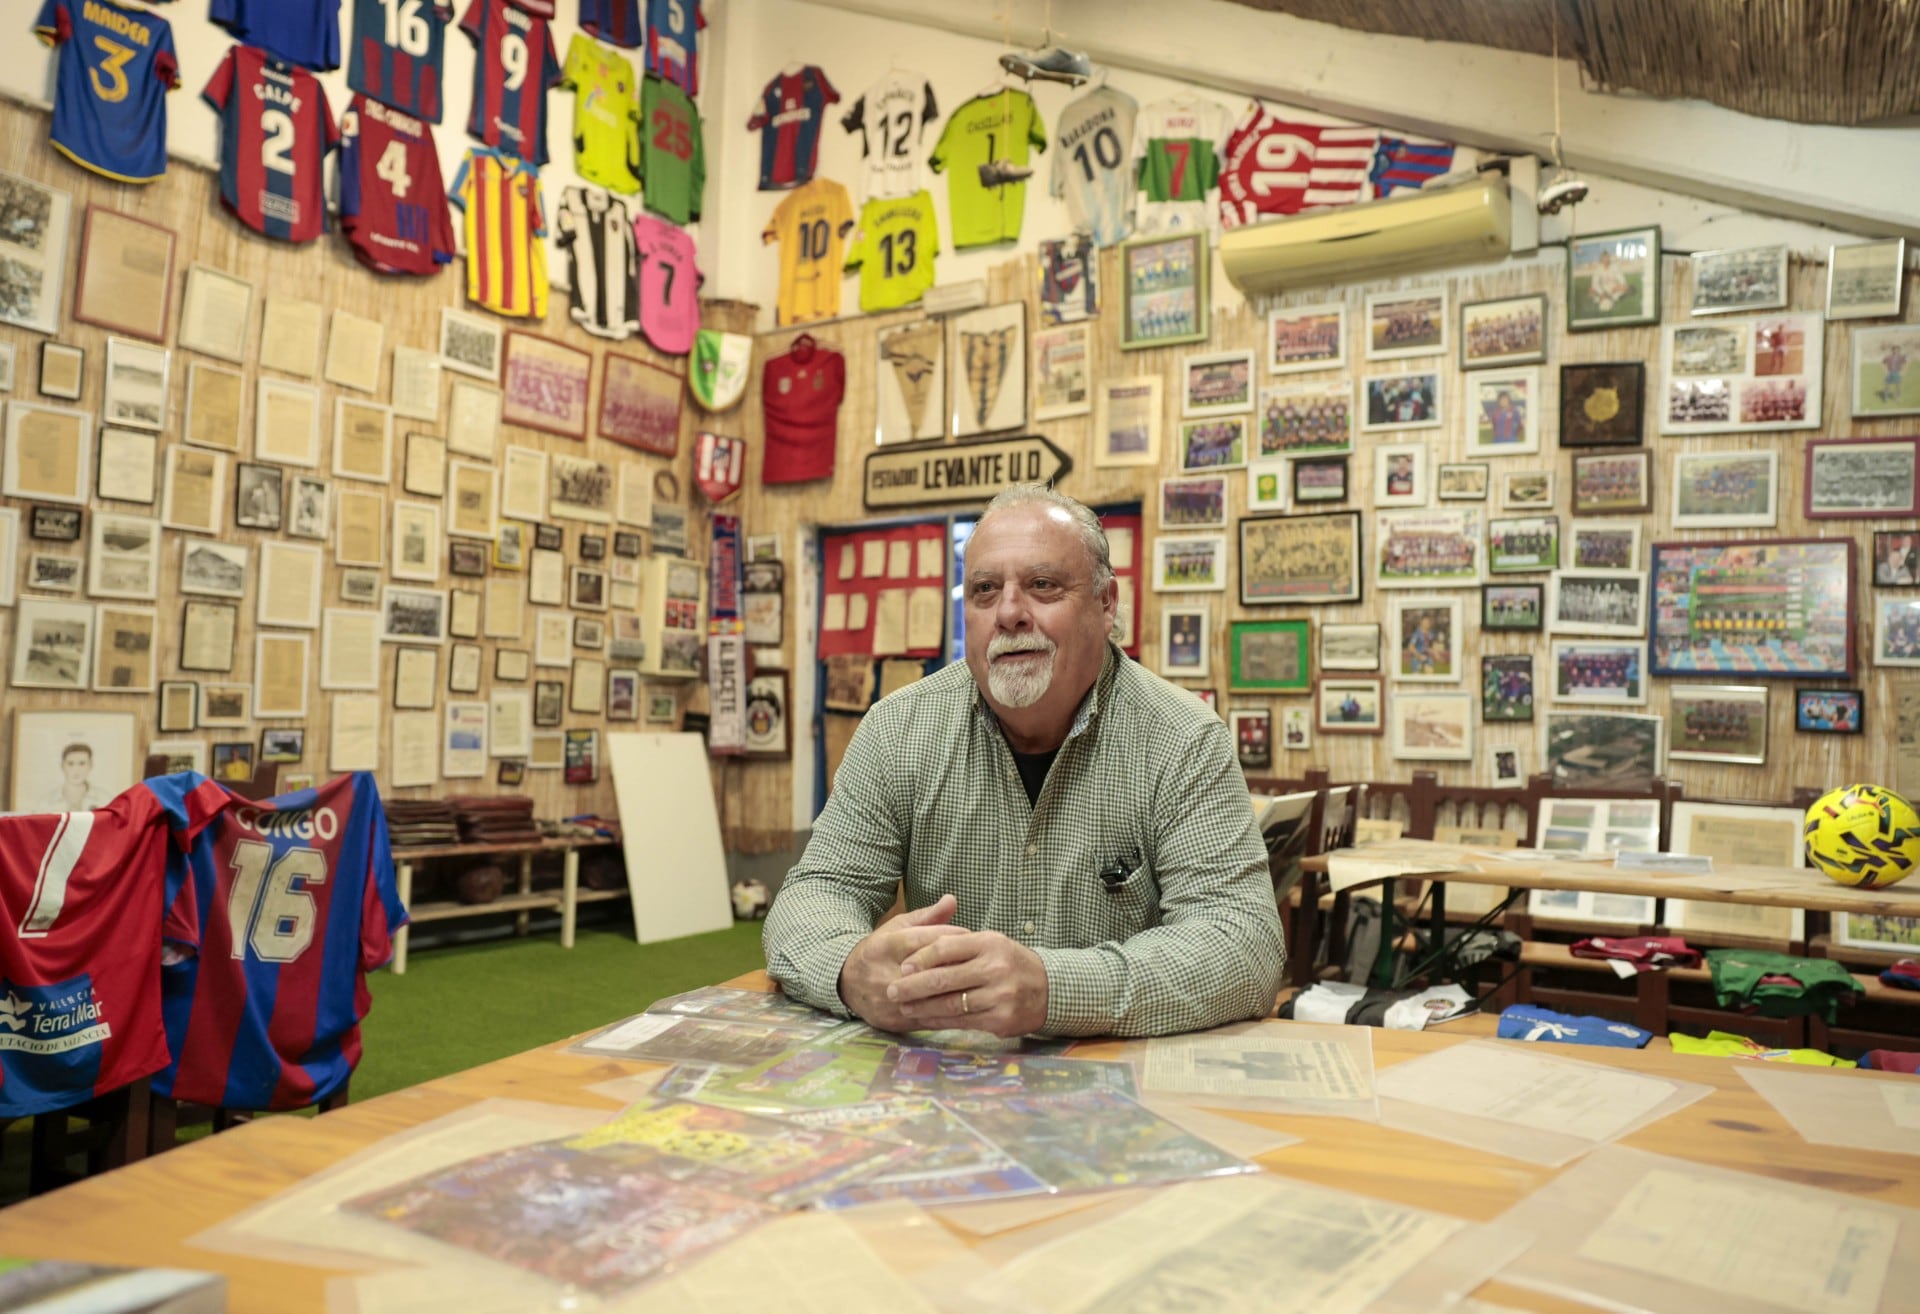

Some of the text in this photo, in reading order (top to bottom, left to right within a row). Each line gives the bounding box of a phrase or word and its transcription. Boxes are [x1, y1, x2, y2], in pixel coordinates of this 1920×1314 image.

[83, 1, 150, 47] MAIDER
[378, 0, 430, 57] 16
[89, 35, 136, 102] 3
[501, 33, 529, 91] 9
[260, 109, 296, 176] 2
[652, 110, 693, 162] 25
[878, 110, 913, 160] 12
[1073, 126, 1123, 182] 10
[376, 140, 412, 198] 4
[1164, 141, 1191, 200] 7
[800, 219, 830, 262] 10
[880, 229, 916, 279] 13
[658, 260, 676, 306] 7
[924, 454, 1003, 490] LEVANTE
[235, 806, 338, 841] CONGO
[228, 838, 328, 963] 16
[39, 987, 97, 1011] VALENCIA
